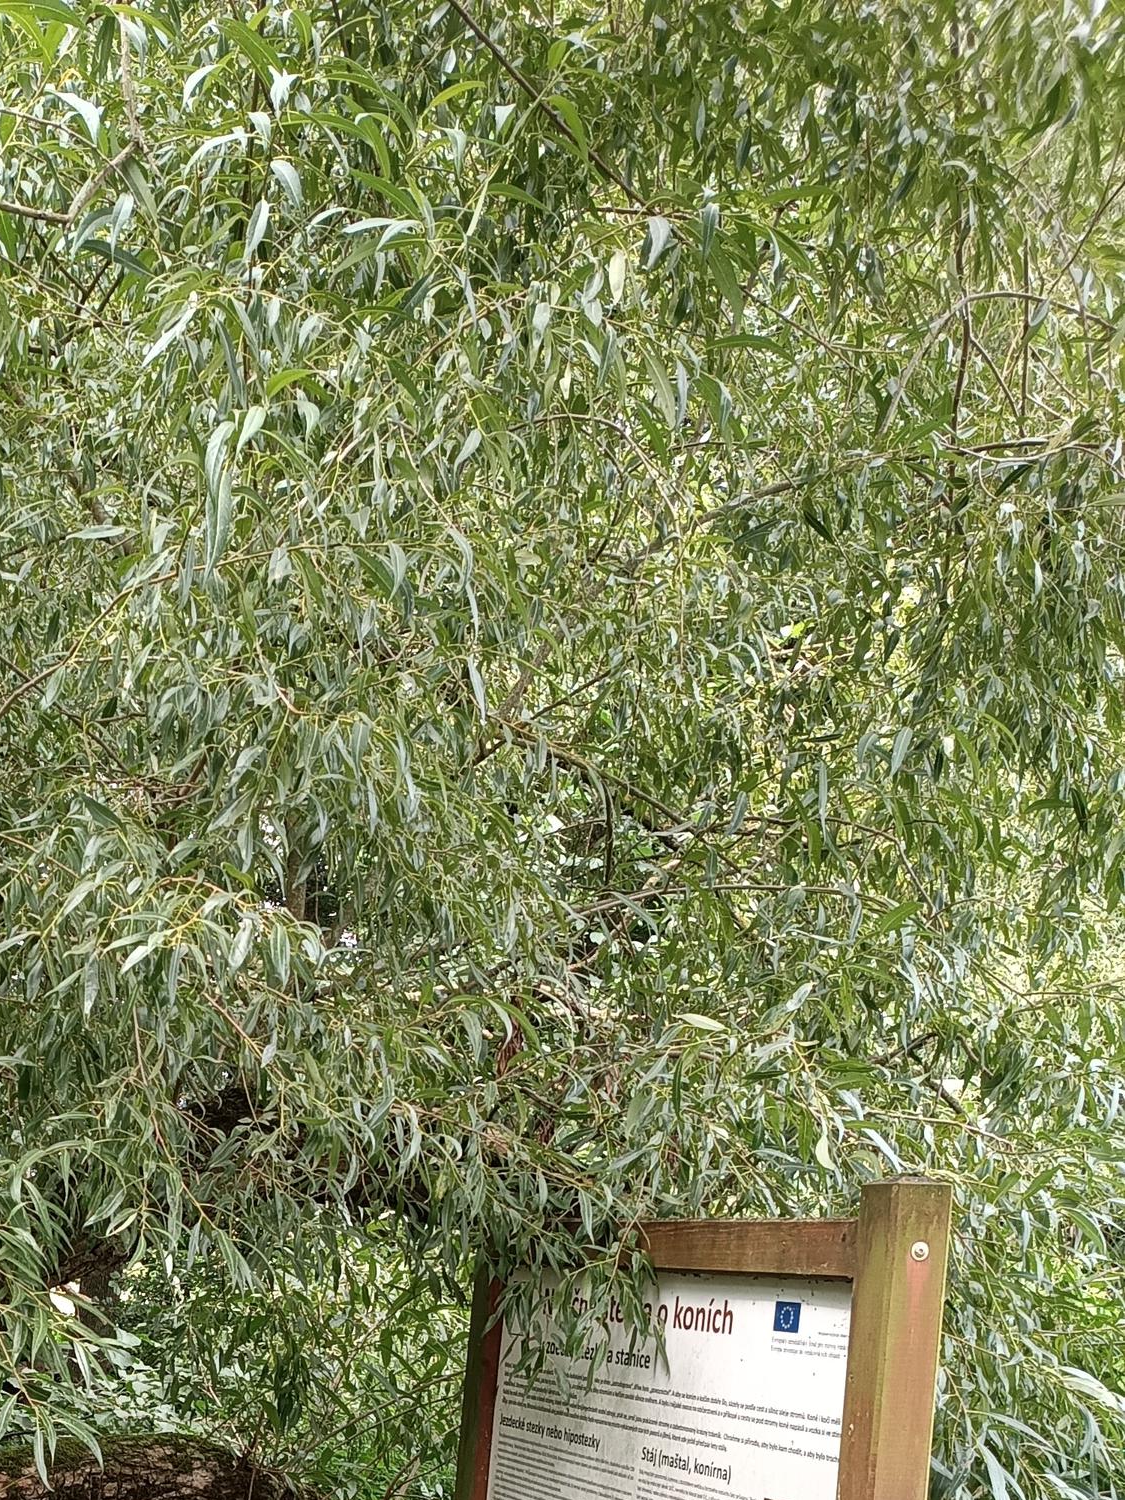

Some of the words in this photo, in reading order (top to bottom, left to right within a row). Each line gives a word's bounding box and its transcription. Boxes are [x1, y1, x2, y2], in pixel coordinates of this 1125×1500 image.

[673, 1296, 733, 1335] koních
[607, 1350, 613, 1364] a
[615, 1349, 651, 1369] stanice
[499, 1413, 526, 1431] Jezdecké
[526, 1421, 545, 1439] stezky
[546, 1425, 563, 1440] nebo
[563, 1428, 600, 1453] hipostezky
[641, 1446, 657, 1467] Stáj
[658, 1449, 691, 1475] (maštal,
[693, 1458, 732, 1485] konírna)
